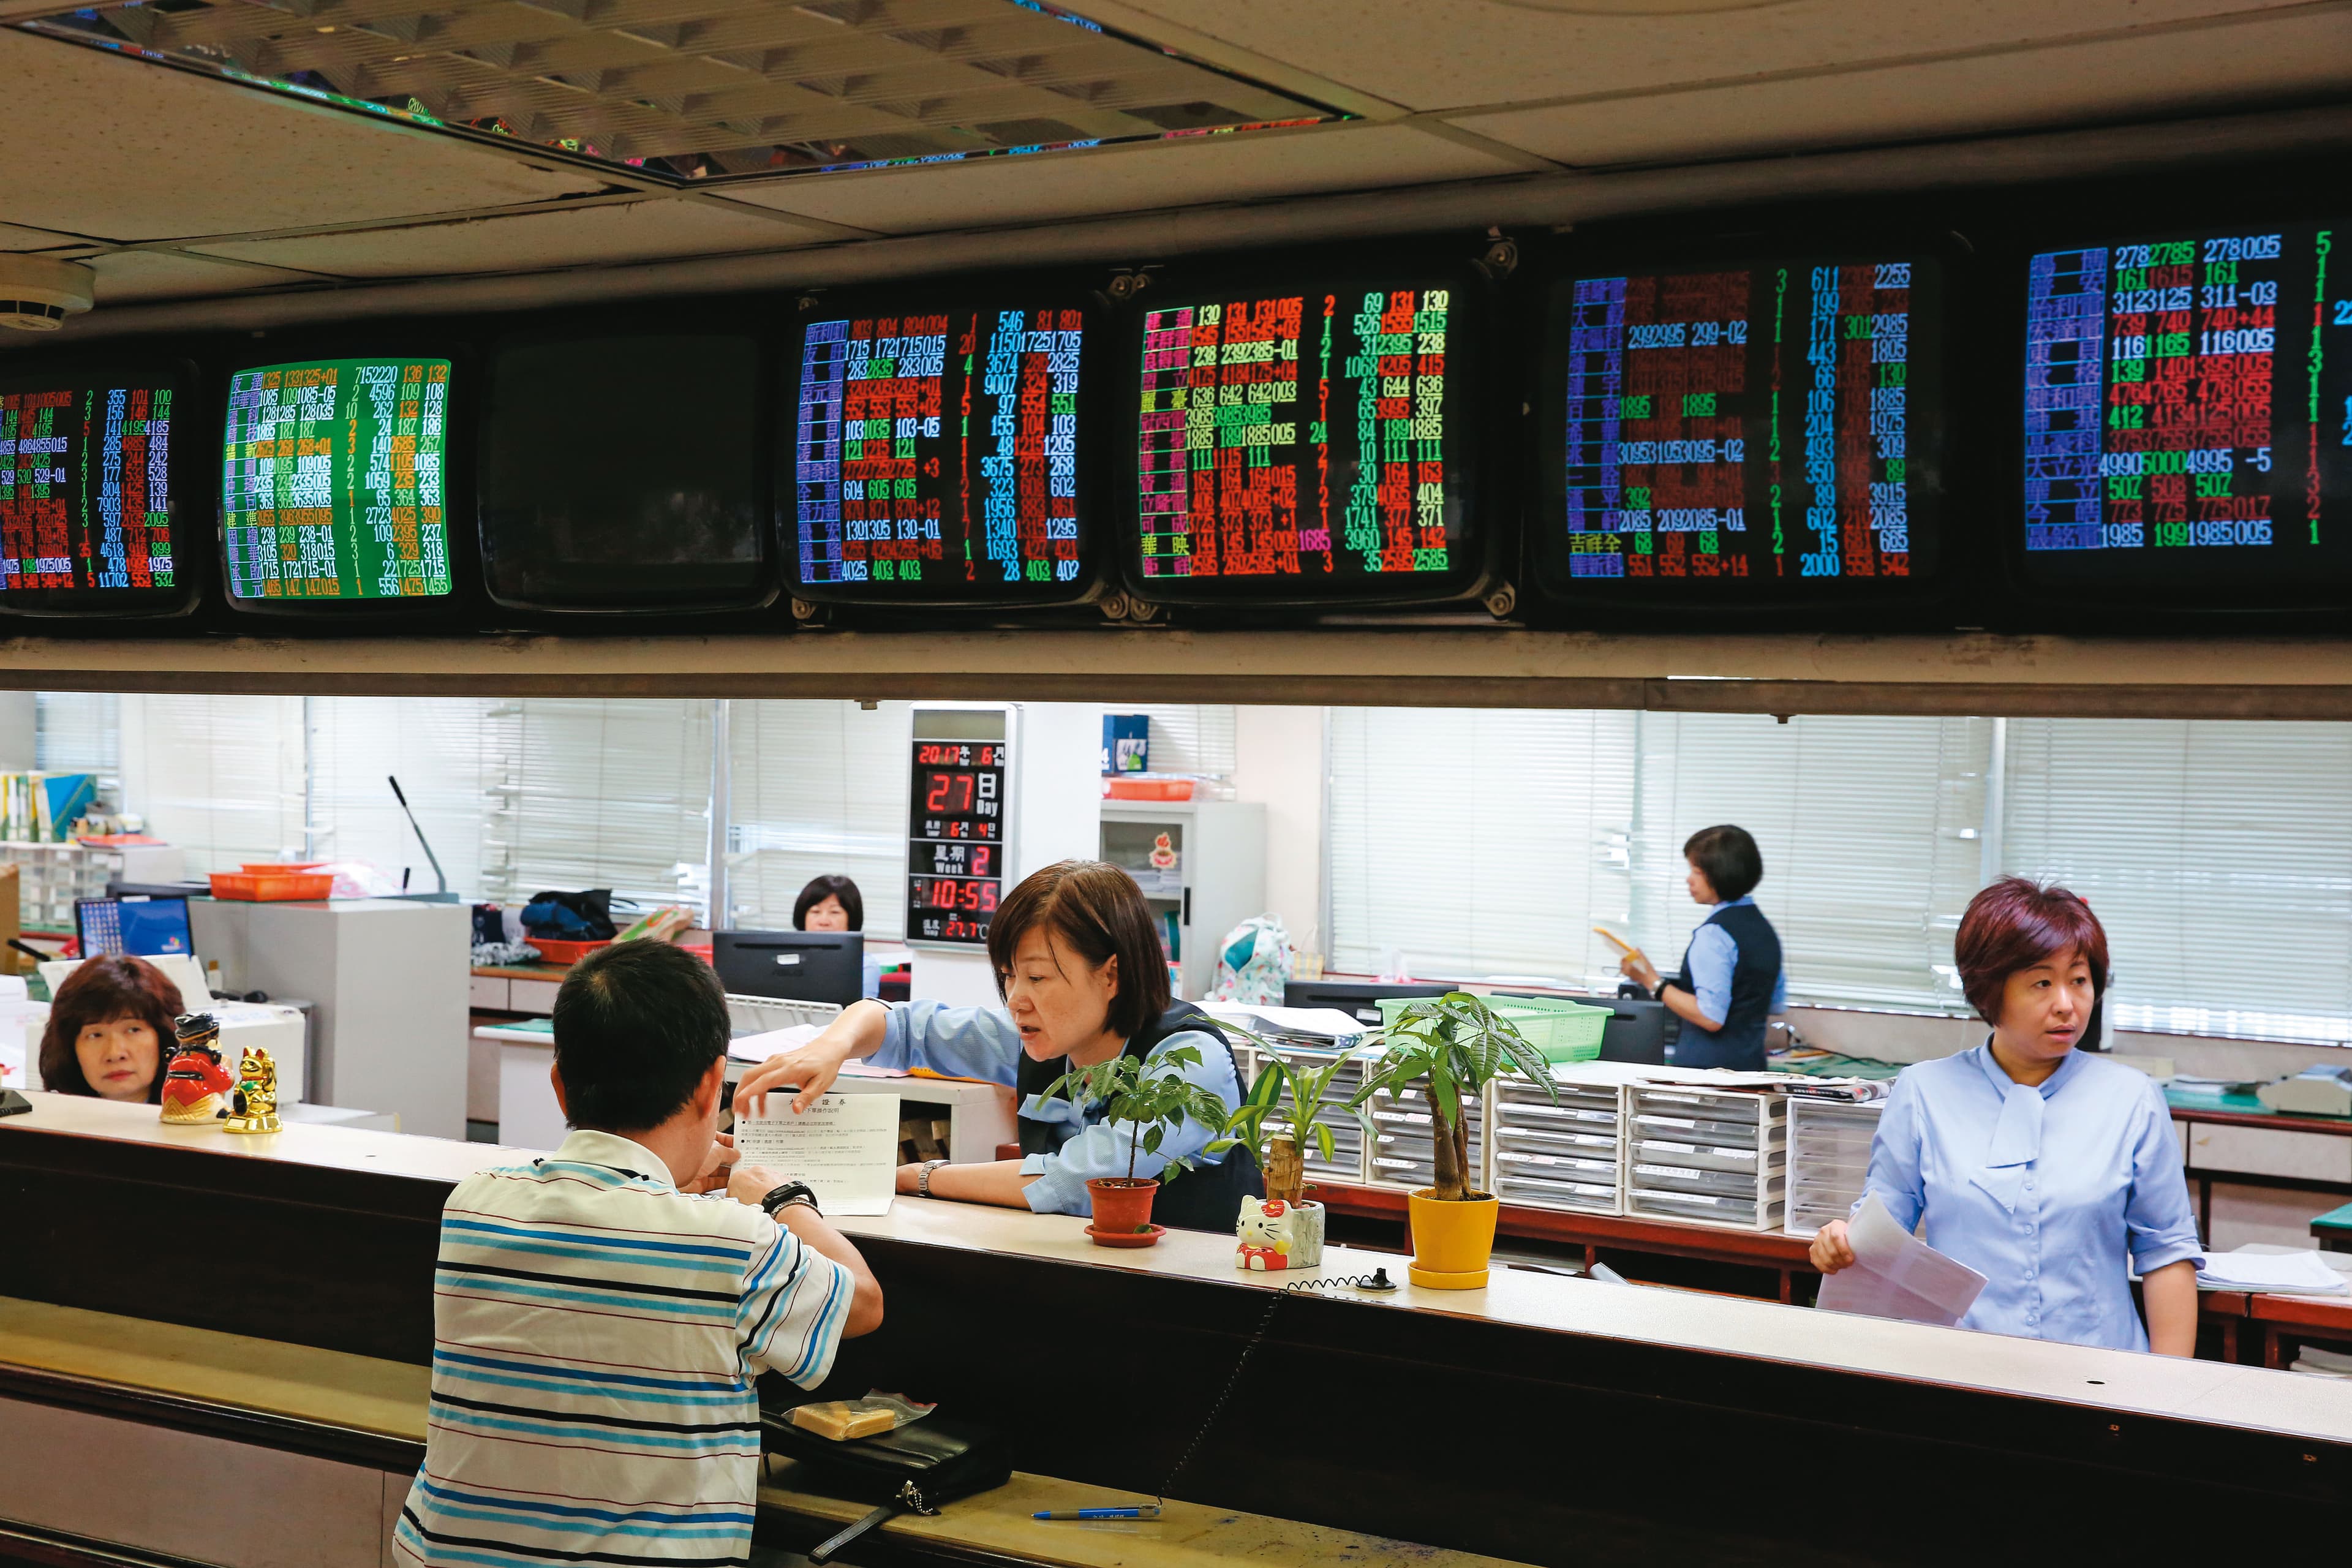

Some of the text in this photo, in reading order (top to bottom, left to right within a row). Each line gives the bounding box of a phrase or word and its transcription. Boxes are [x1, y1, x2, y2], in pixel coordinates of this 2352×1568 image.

[2315, 231, 2332, 254] 5
[1776, 263, 1911, 293] 3 611 2255
[2116, 261, 2239, 292] 161 161
[1198, 290, 1448, 326] 130 2 69 130
[998, 311, 1024, 332] 546
[1810, 316, 1836, 341] 171
[2113, 313, 2145, 336] 739
[2156, 311, 2190, 333] 740
[1194, 333, 1445, 367] 238 2 238
[1872, 339, 1907, 363] 1805
[403, 365, 423, 382] 136
[427, 365, 447, 382] 132
[964, 353, 1019, 375] 4 3674
[1880, 363, 1906, 387] 130
[2112, 349, 2323, 383] 139 3
[352, 385, 359, 401] 2
[369, 383, 395, 401] 4596
[401, 383, 420, 401] 109
[424, 383, 444, 400] 108
[984, 374, 1017, 394] 9007
[1053, 373, 1078, 393] 319
[1193, 375, 1444, 407] 636 644 636
[86, 390, 172, 405] 2 355 101 100
[1052, 394, 1077, 414] 551
[1415, 397, 1442, 418] 397
[1683, 389, 1835, 417] 1895 106
[39, 405, 170, 423] 144 156 144
[345, 401, 442, 419] 10 262 132 128
[2109, 404, 2143, 430] 412
[279, 418, 442, 439] 187 187 187 186
[991, 415, 1016, 435] 155
[1052, 415, 1076, 435] 103
[149, 436, 168, 450] 484
[420, 436, 440, 453] 267
[845, 438, 916, 460] 121 121
[1384, 440, 1442, 462] 111 111
[1805, 435, 1905, 461] 493 309
[149, 451, 167, 466] 242
[981, 457, 1014, 477] 3675
[1050, 456, 1075, 476] 268
[2, 467, 167, 484] 529 530 177 528
[2109, 473, 2233, 500] 507 507
[844, 477, 1076, 500] 604 605 605 323 602
[1417, 483, 1444, 505] 404
[1626, 483, 1906, 510] 392 3915
[421, 507, 441, 523] 390
[984, 498, 1015, 518] 1956
[1345, 505, 1444, 528] 1741 371
[2307, 496, 2320, 519] 2
[104, 512, 121, 527] 597
[1046, 518, 1077, 538] 1295
[1619, 506, 1907, 532] 2085 602 2085
[105, 527, 170, 542] 487 706
[261, 527, 276, 544] 238
[279, 526, 295, 543] 239
[422, 524, 442, 541] 237
[1298, 529, 1332, 551] 1685
[1345, 529, 1380, 550] 3960
[1420, 527, 1446, 548] 142
[1569, 529, 1909, 555] 吉祥全 68 15 665
[2101, 519, 2320, 548] 1985 199 1
[100, 542, 171, 557] 4618 899
[387, 542, 443, 559] 6 318
[108, 557, 126, 572] 478
[842, 560, 1079, 581] 4025 403 28 402
[99, 572, 175, 587] 11702 537
[379, 578, 399, 595] 556
[927, 773, 997, 810] 27 日
[977, 799, 998, 817] Day
[972, 846, 990, 875] 2
[932, 880, 997, 911] 10:55
